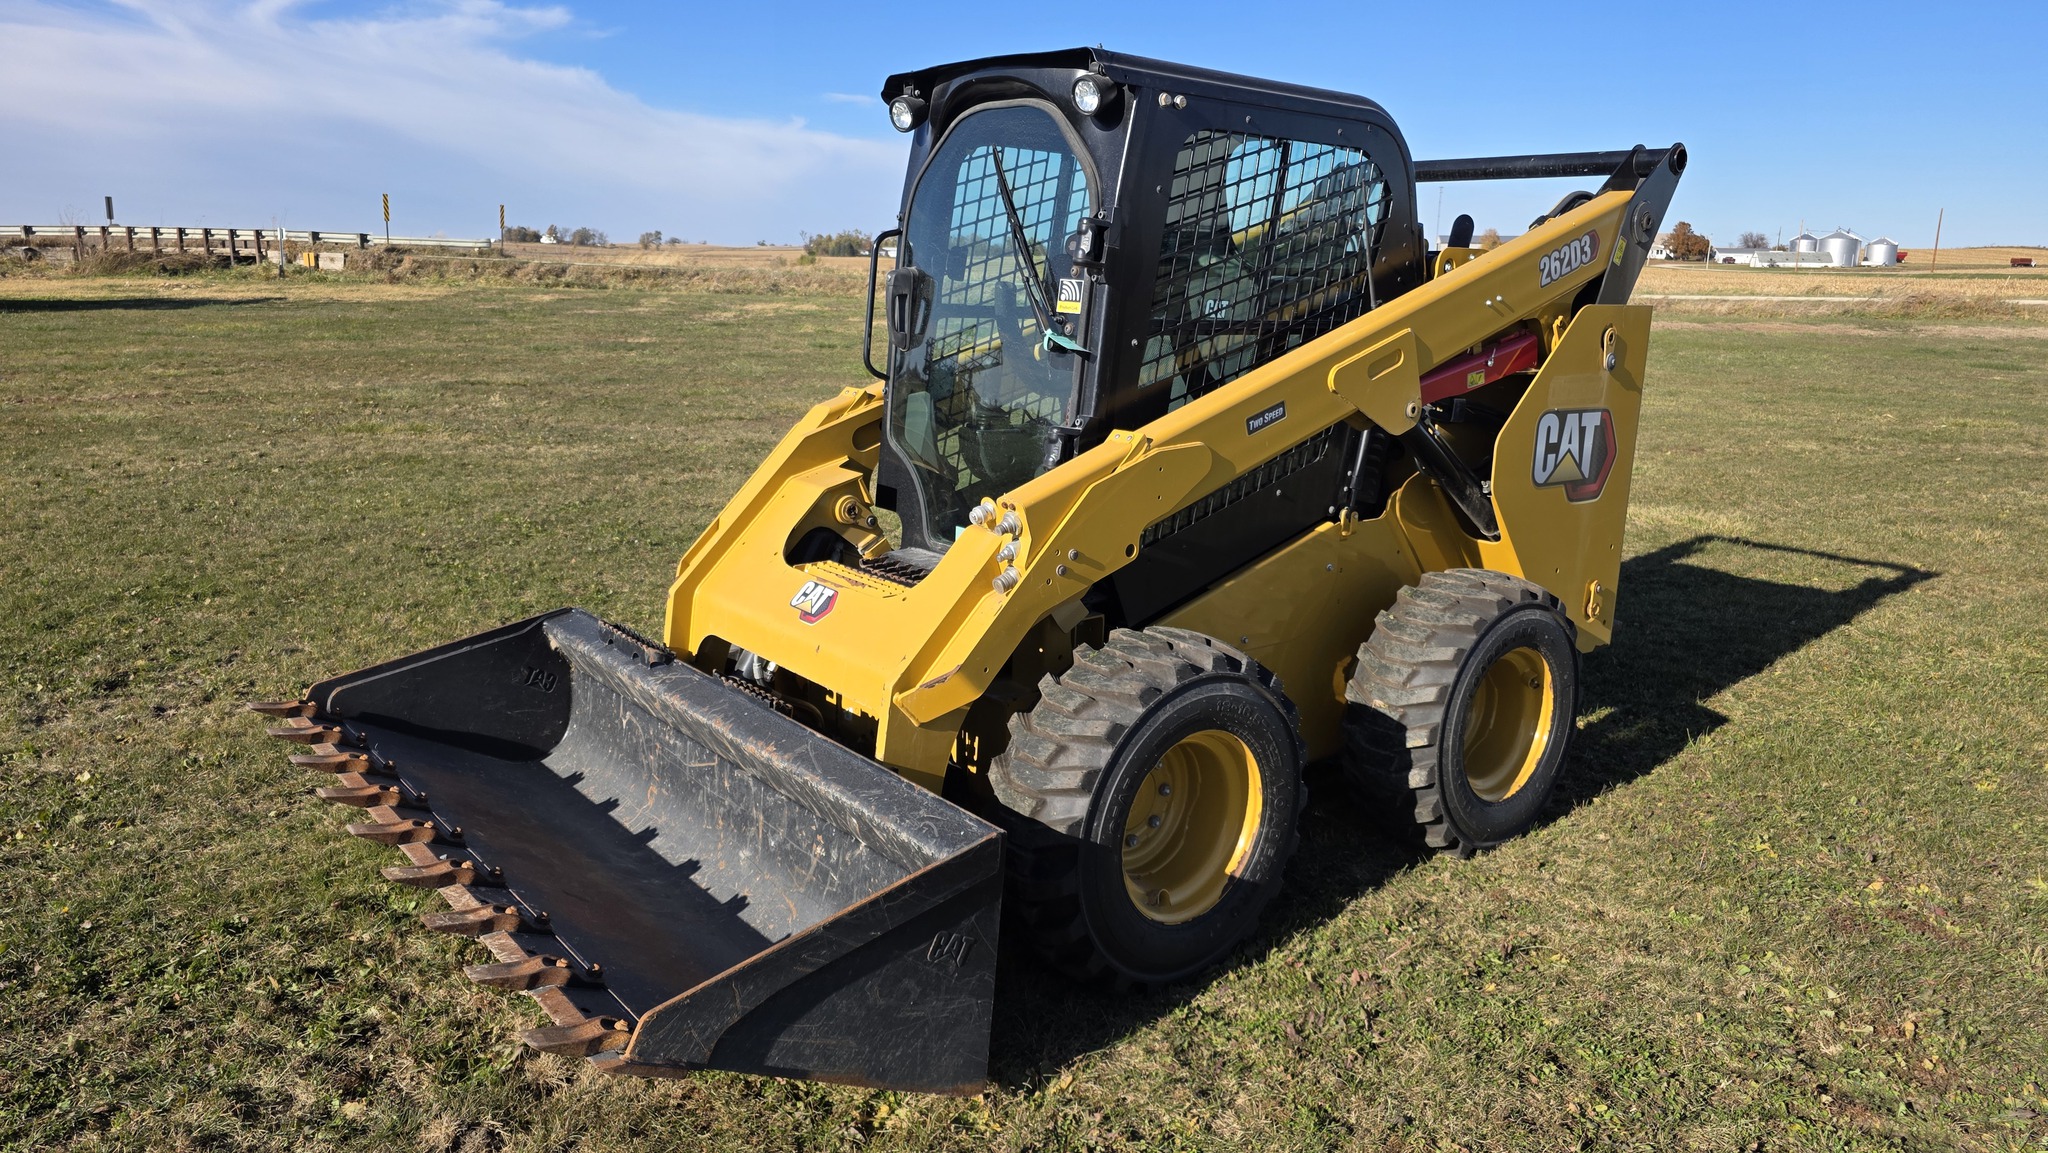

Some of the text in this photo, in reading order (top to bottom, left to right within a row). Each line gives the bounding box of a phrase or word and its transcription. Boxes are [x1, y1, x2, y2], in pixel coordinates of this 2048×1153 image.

[1540, 235, 1591, 286] 262D3
[1205, 300, 1229, 318] CAT
[1534, 412, 1602, 484] CAT
[791, 581, 836, 615] CAT
[927, 930, 977, 968] CAT
